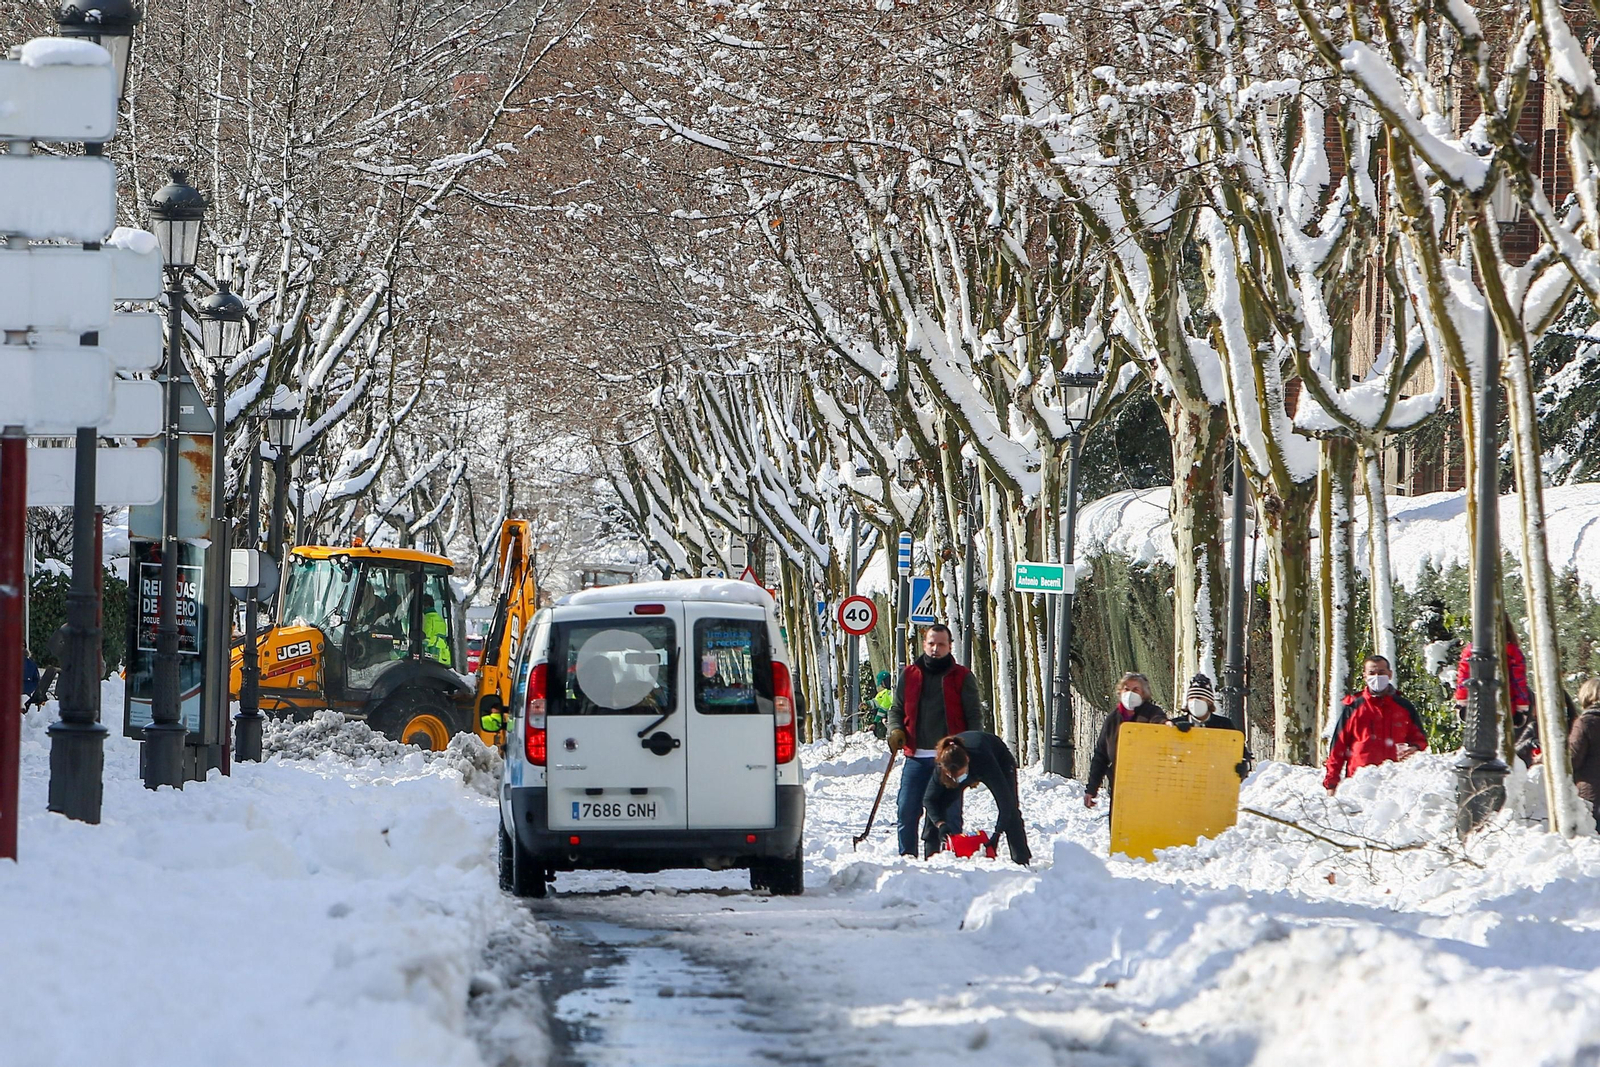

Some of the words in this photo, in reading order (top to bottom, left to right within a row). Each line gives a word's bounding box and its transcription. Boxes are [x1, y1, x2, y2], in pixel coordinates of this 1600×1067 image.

[143, 580, 196, 598] REJAS
[1018, 576, 1038, 586] Antonio
[1040, 577, 1061, 587] Becerril
[143, 598, 158, 613] DE
[845, 608, 870, 622] 40
[277, 641, 311, 660] JCB
[582, 803, 622, 818] 7686
[627, 802, 656, 818] GNH
